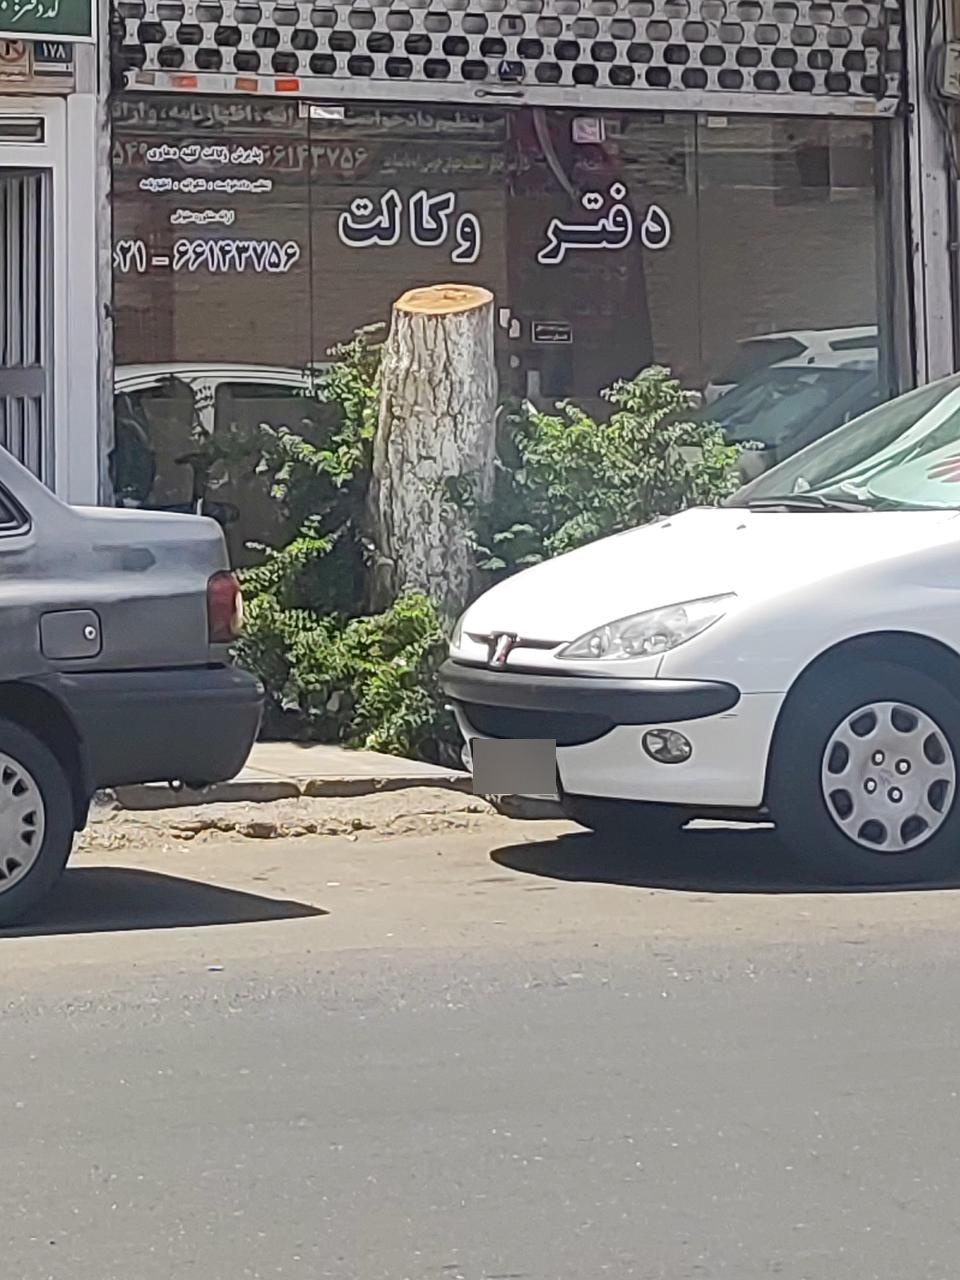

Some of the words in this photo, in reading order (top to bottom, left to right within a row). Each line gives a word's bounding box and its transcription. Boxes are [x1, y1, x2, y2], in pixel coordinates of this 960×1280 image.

[42, 41, 67, 59] ۱۷۸
[338, 188, 482, 263] وکالت
[537, 182, 671, 264] دفتر
[172, 238, 300, 272] ۶۶۱۴۳۷۵۶
